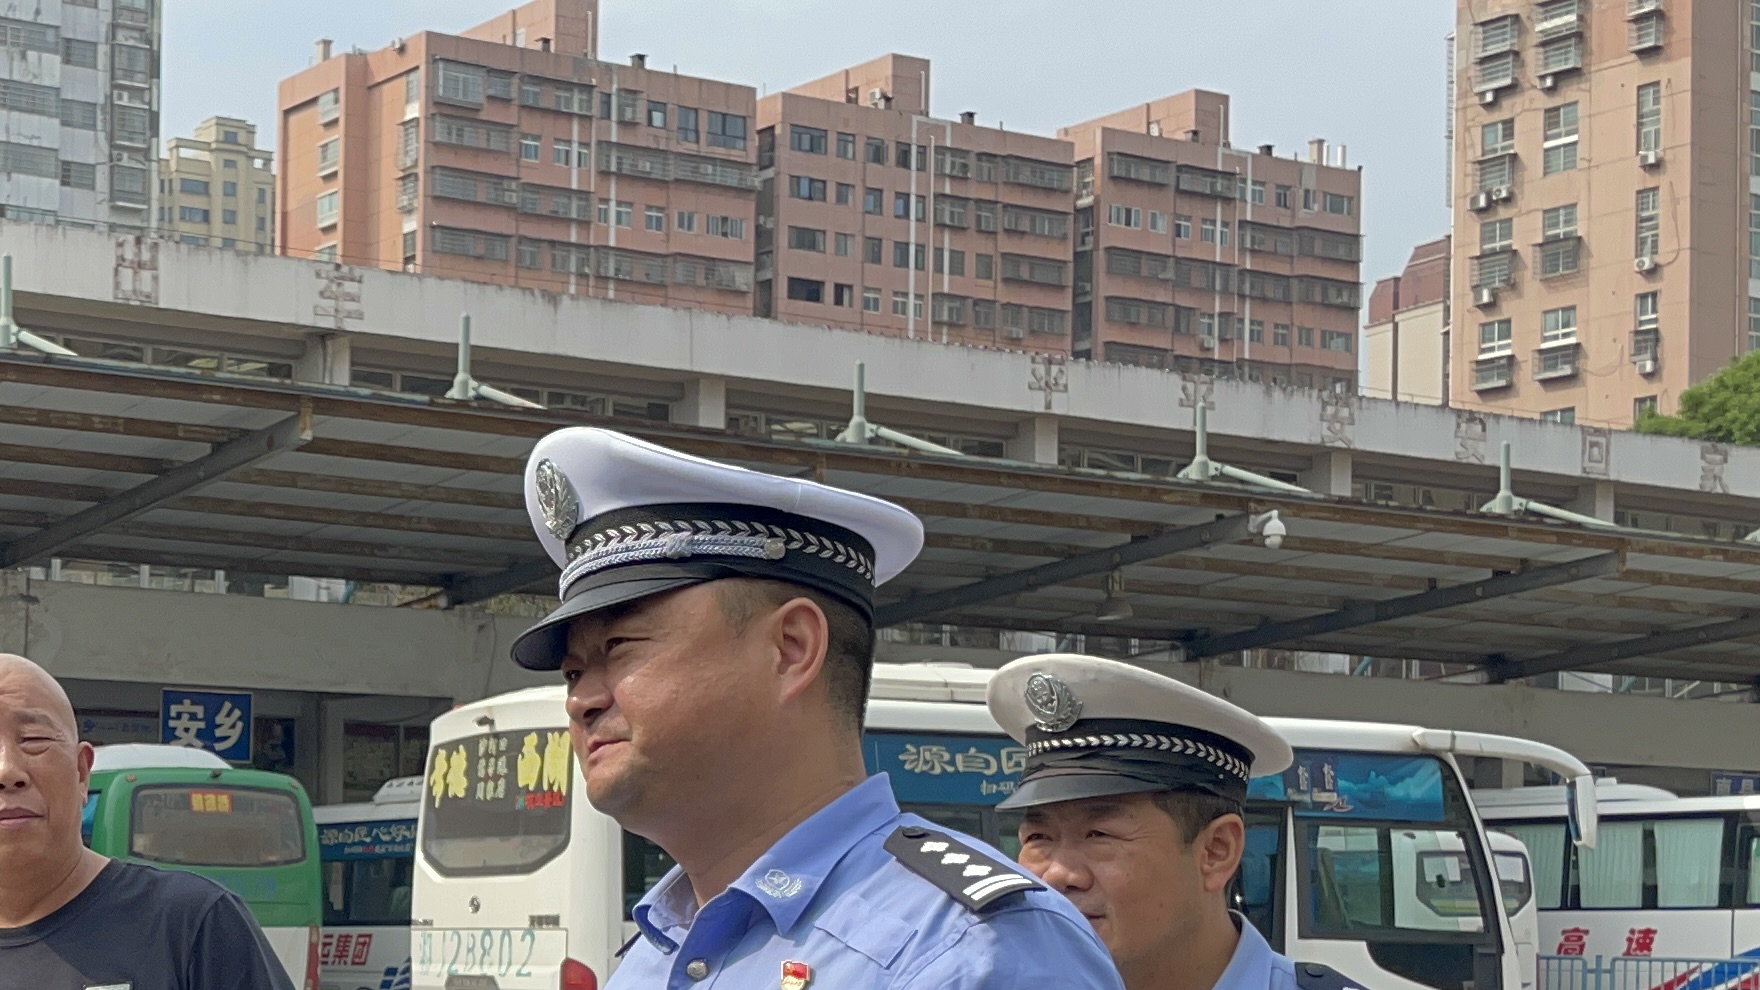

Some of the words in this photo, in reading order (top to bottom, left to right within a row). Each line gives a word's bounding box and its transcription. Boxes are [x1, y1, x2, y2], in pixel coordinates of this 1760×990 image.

[168, 699, 245, 751] 安乡
[321, 824, 418, 845] 源自匠心好
